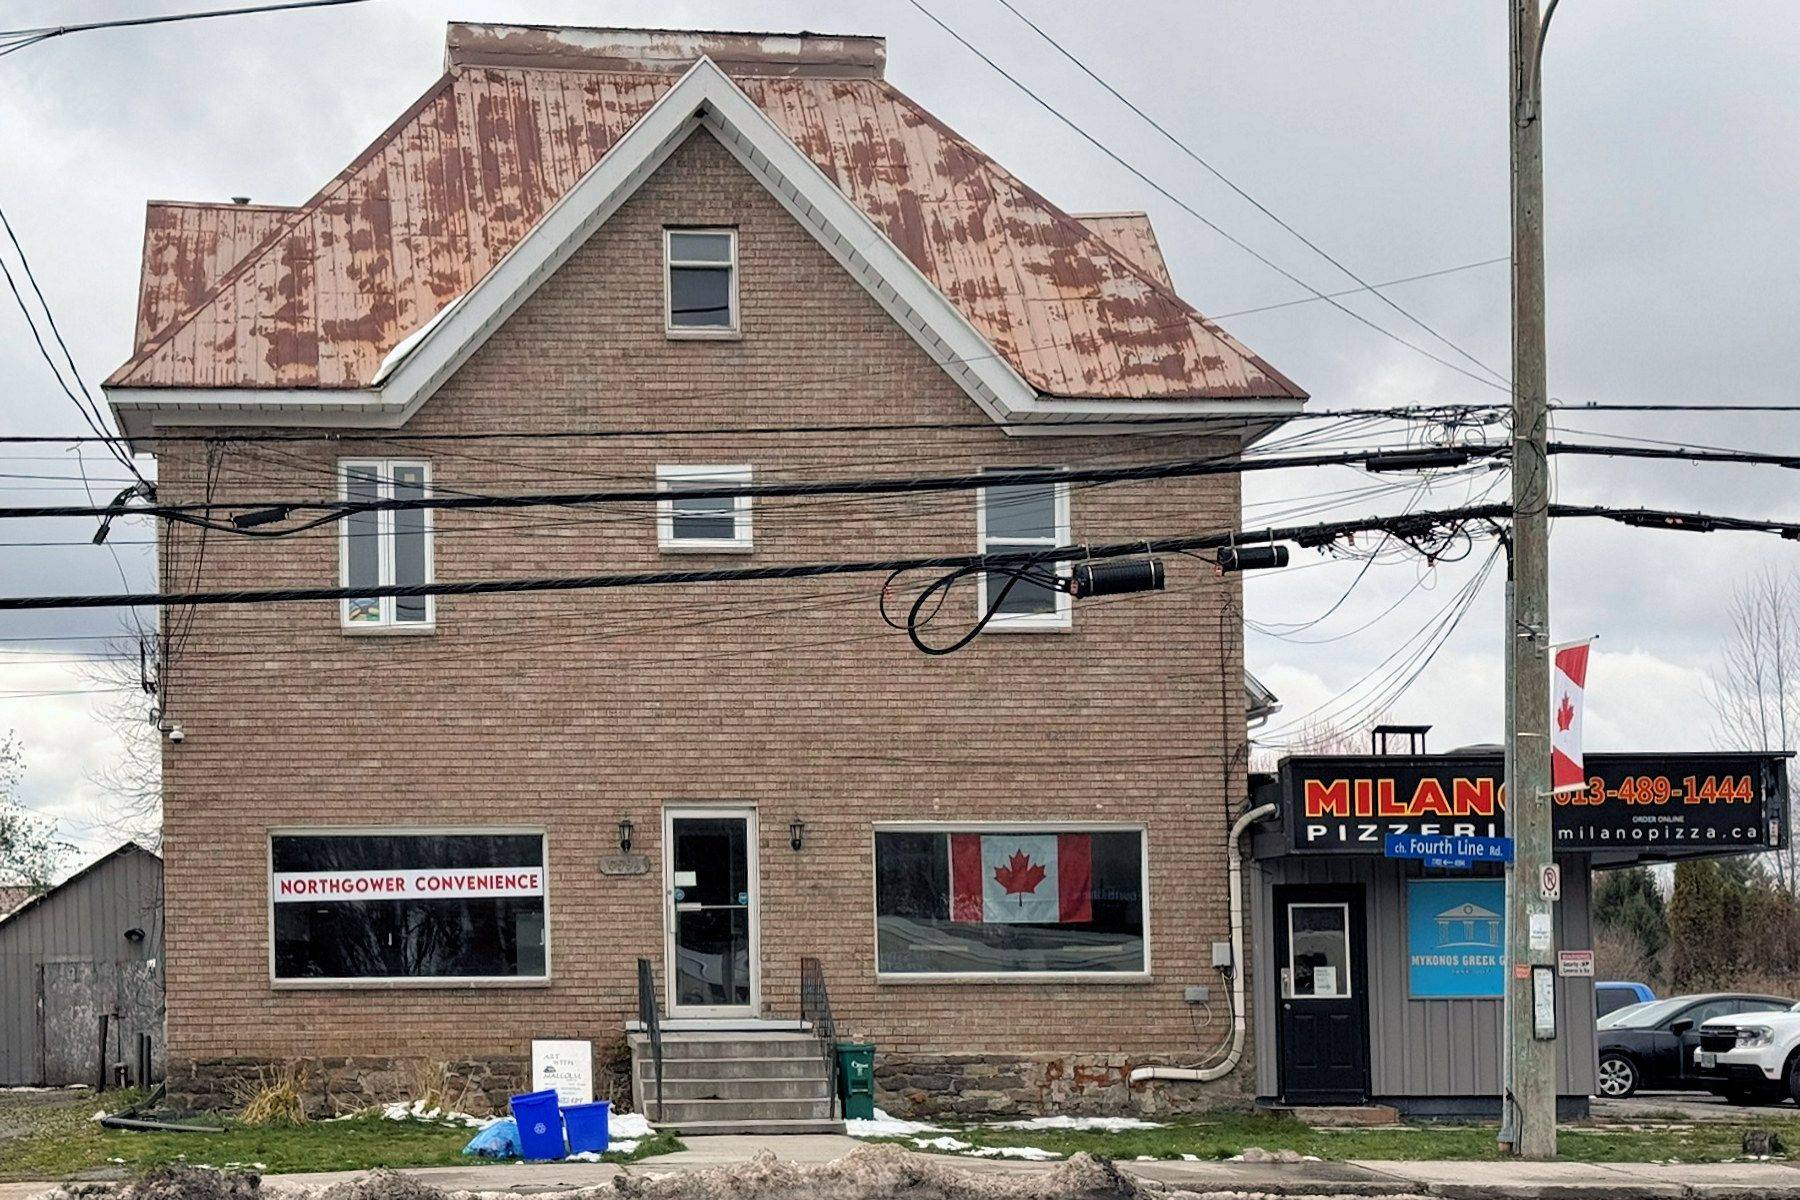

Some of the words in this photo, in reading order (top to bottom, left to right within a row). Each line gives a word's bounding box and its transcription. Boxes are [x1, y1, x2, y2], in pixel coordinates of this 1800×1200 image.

[1304, 777, 1506, 817] MILAN
[1632, 815, 1656, 823] ORDER
[1658, 815, 1684, 823] ONLINE
[1307, 823, 1496, 841] PIZZERI
[1558, 825, 1757, 841] milanopizza.ca
[1394, 842, 1407, 853] ch.
[1410, 839, 1452, 855] Fourth
[1458, 839, 1484, 856] Line
[1489, 845, 1503, 856] Rd.
[280, 877, 406, 895] NORTHGOWER
[415, 874, 539, 891] CONVENIENCE
[1411, 955, 1459, 966] MYKONOS
[1462, 955, 1495, 966] GREEK
